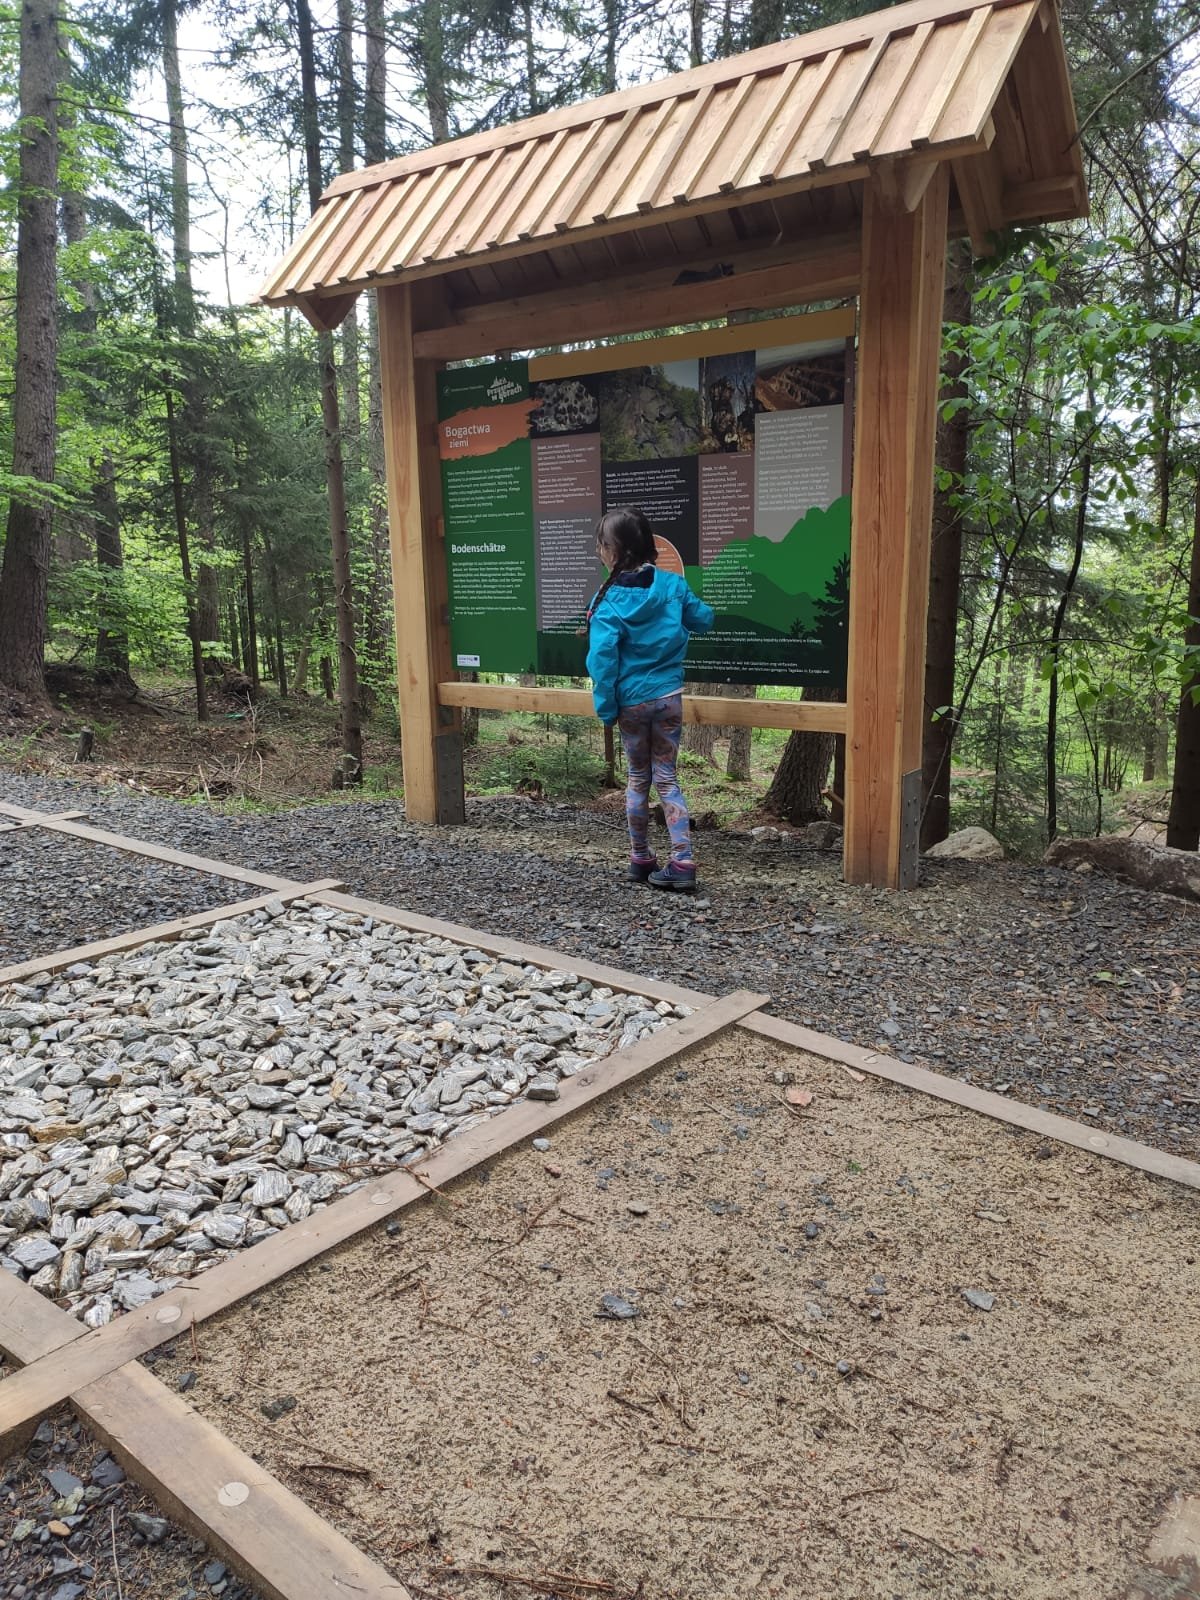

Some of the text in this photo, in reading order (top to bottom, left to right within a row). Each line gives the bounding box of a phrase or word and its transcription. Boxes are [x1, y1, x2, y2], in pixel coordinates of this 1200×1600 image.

[445, 424, 490, 438] Bogactwa
[449, 438, 469, 448] ziemi
[451, 542, 506, 553] Bodenschätze
